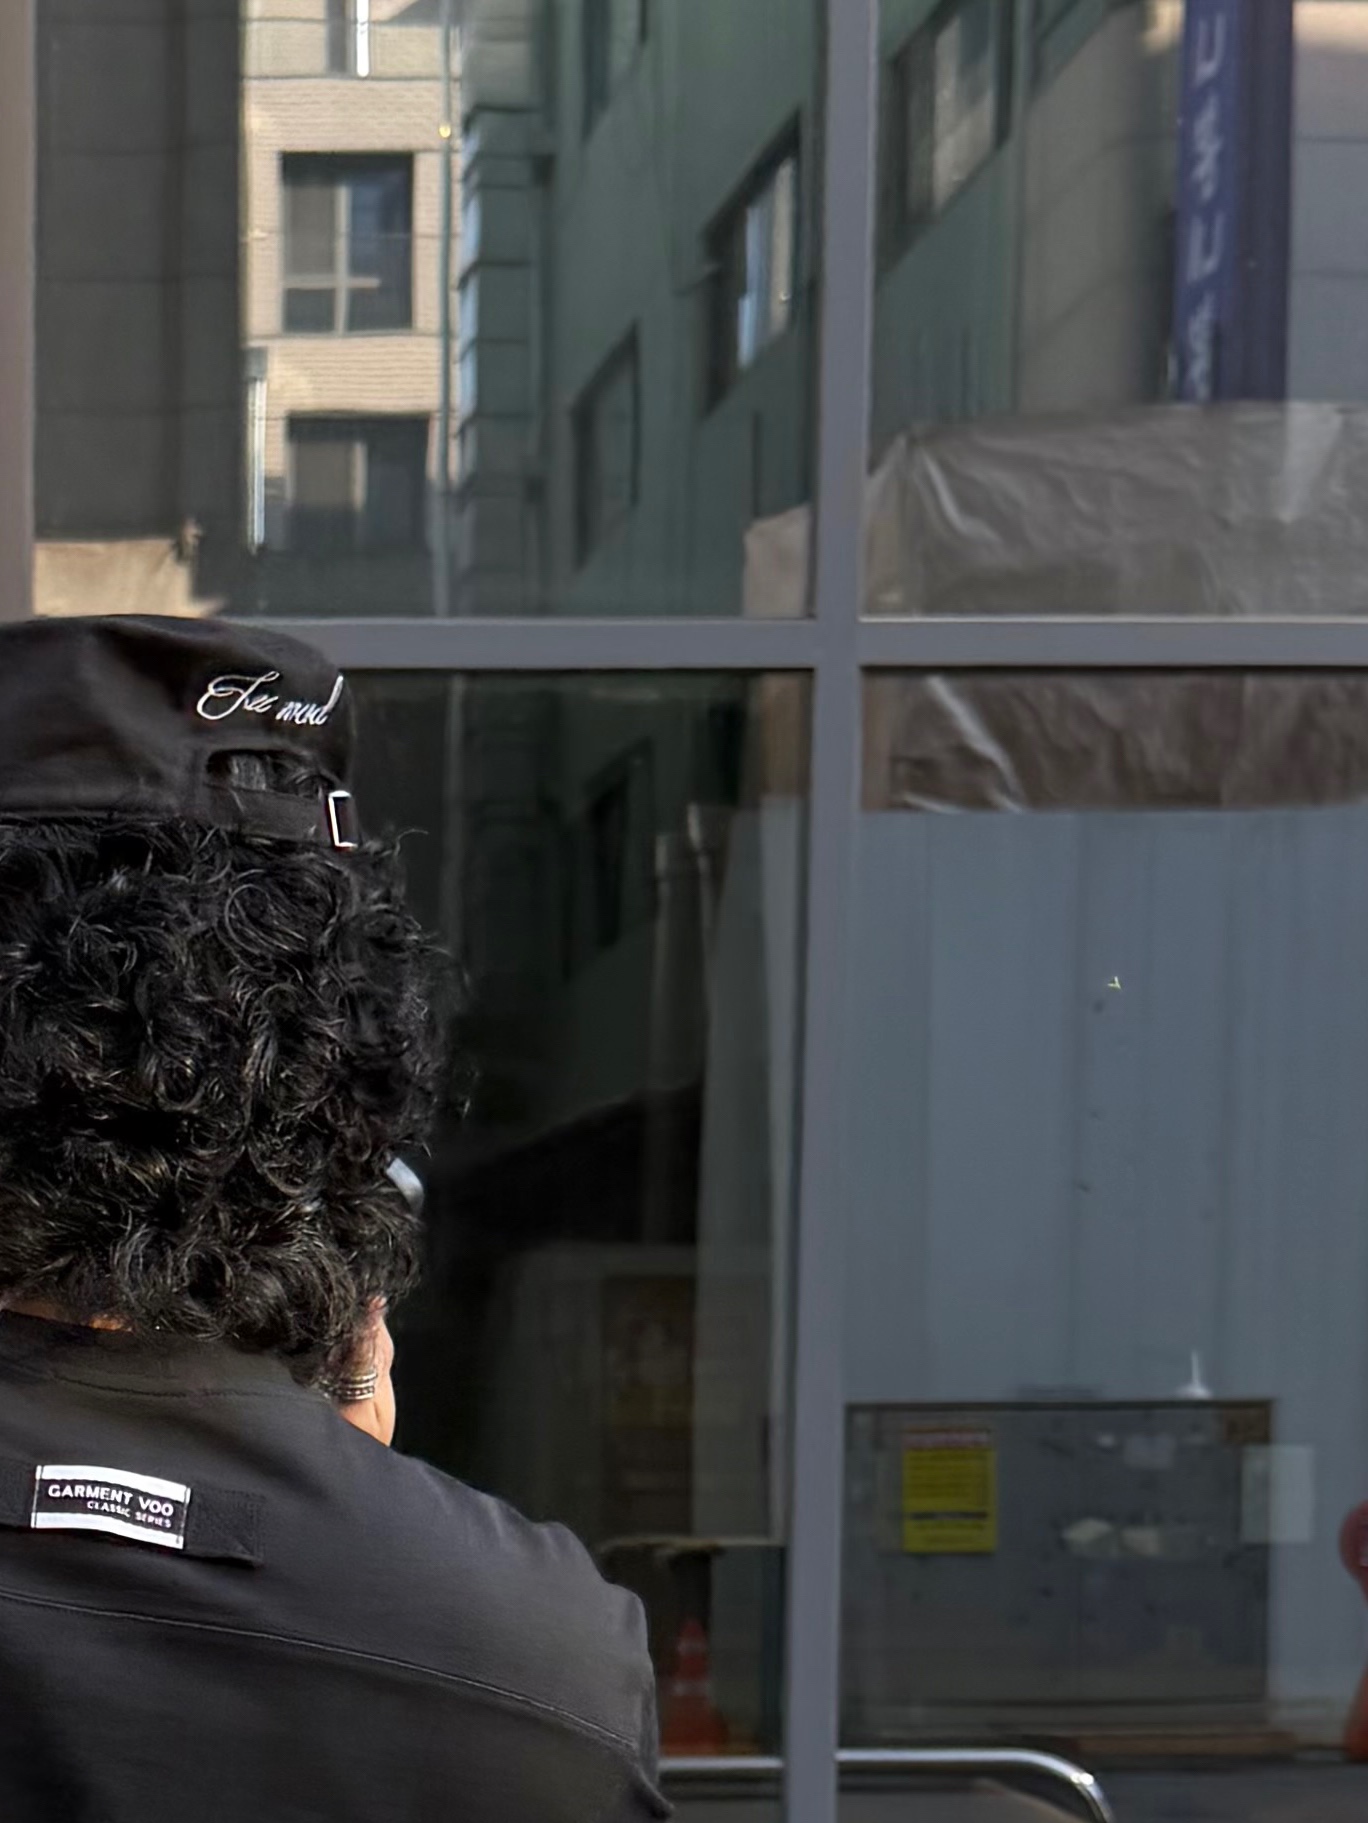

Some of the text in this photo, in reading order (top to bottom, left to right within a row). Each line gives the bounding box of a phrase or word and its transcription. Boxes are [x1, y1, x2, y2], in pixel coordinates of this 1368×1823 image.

[47, 1484, 175, 1517] GARMENT VOO
[86, 1500, 173, 1529] CLASSIC SERIES
